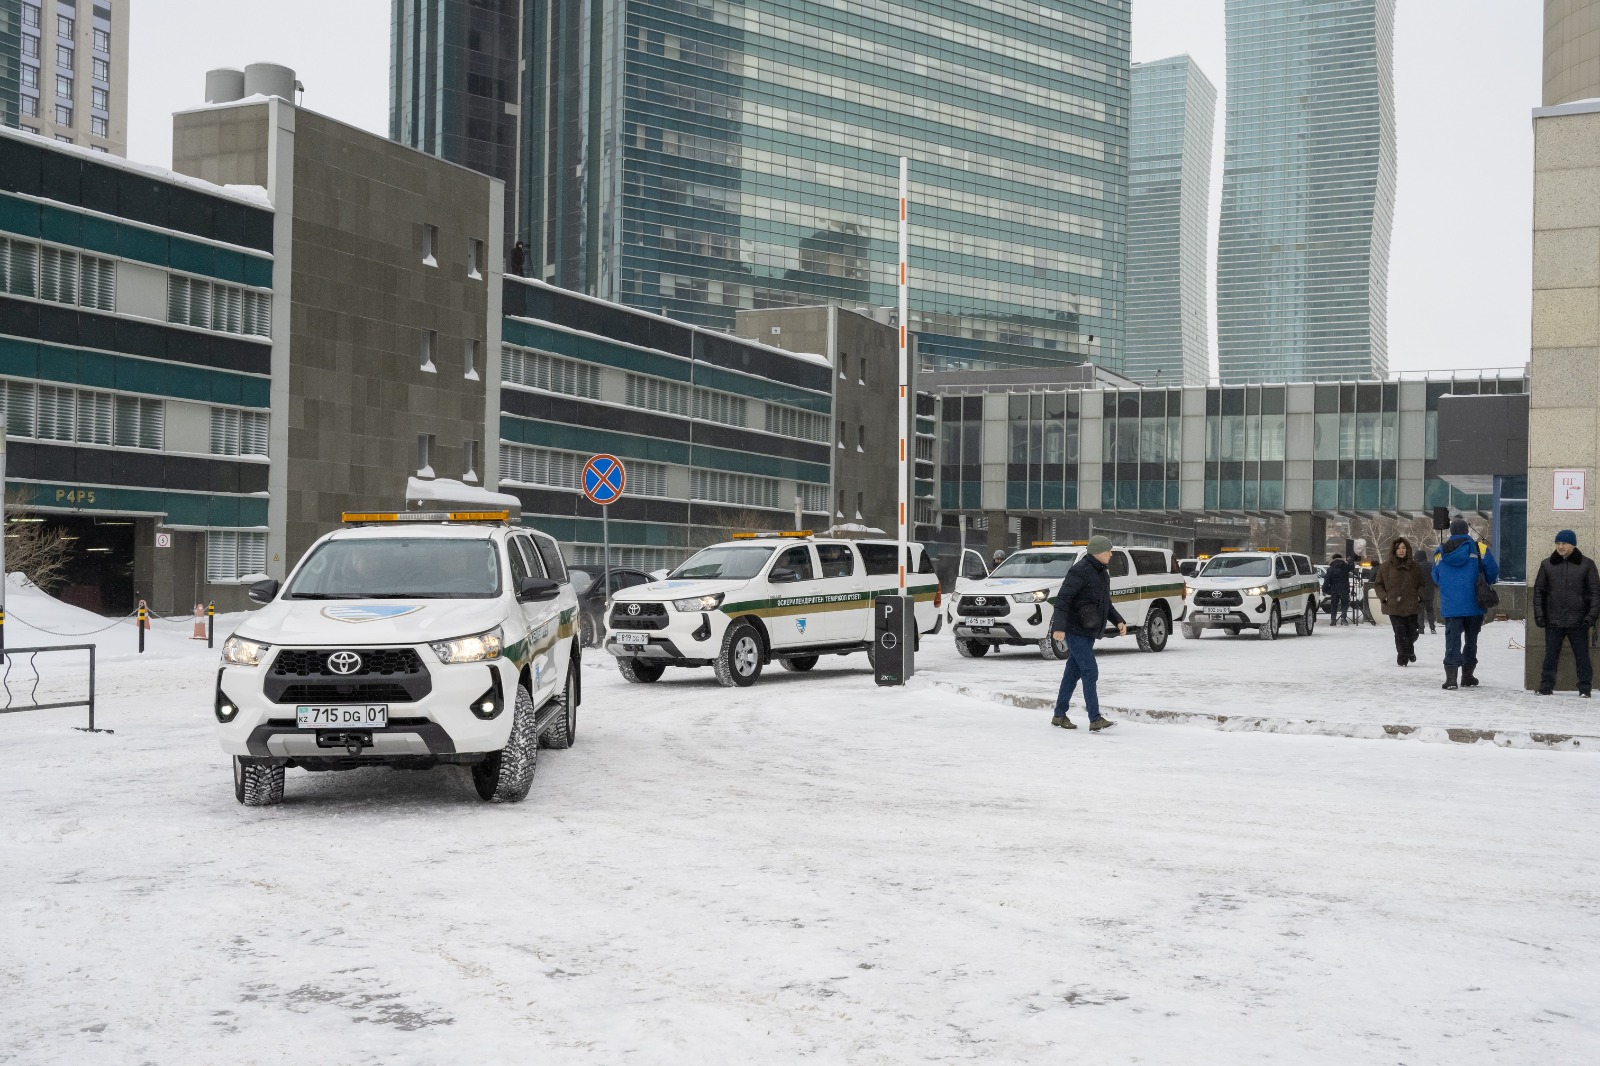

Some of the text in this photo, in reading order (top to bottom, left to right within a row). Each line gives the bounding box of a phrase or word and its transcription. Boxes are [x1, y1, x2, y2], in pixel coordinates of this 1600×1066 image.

[55, 489, 96, 504] P4P5
[884, 605, 894, 619] P
[312, 708, 339, 723] 715
[343, 711, 361, 723] DG
[367, 707, 386, 723] 01
